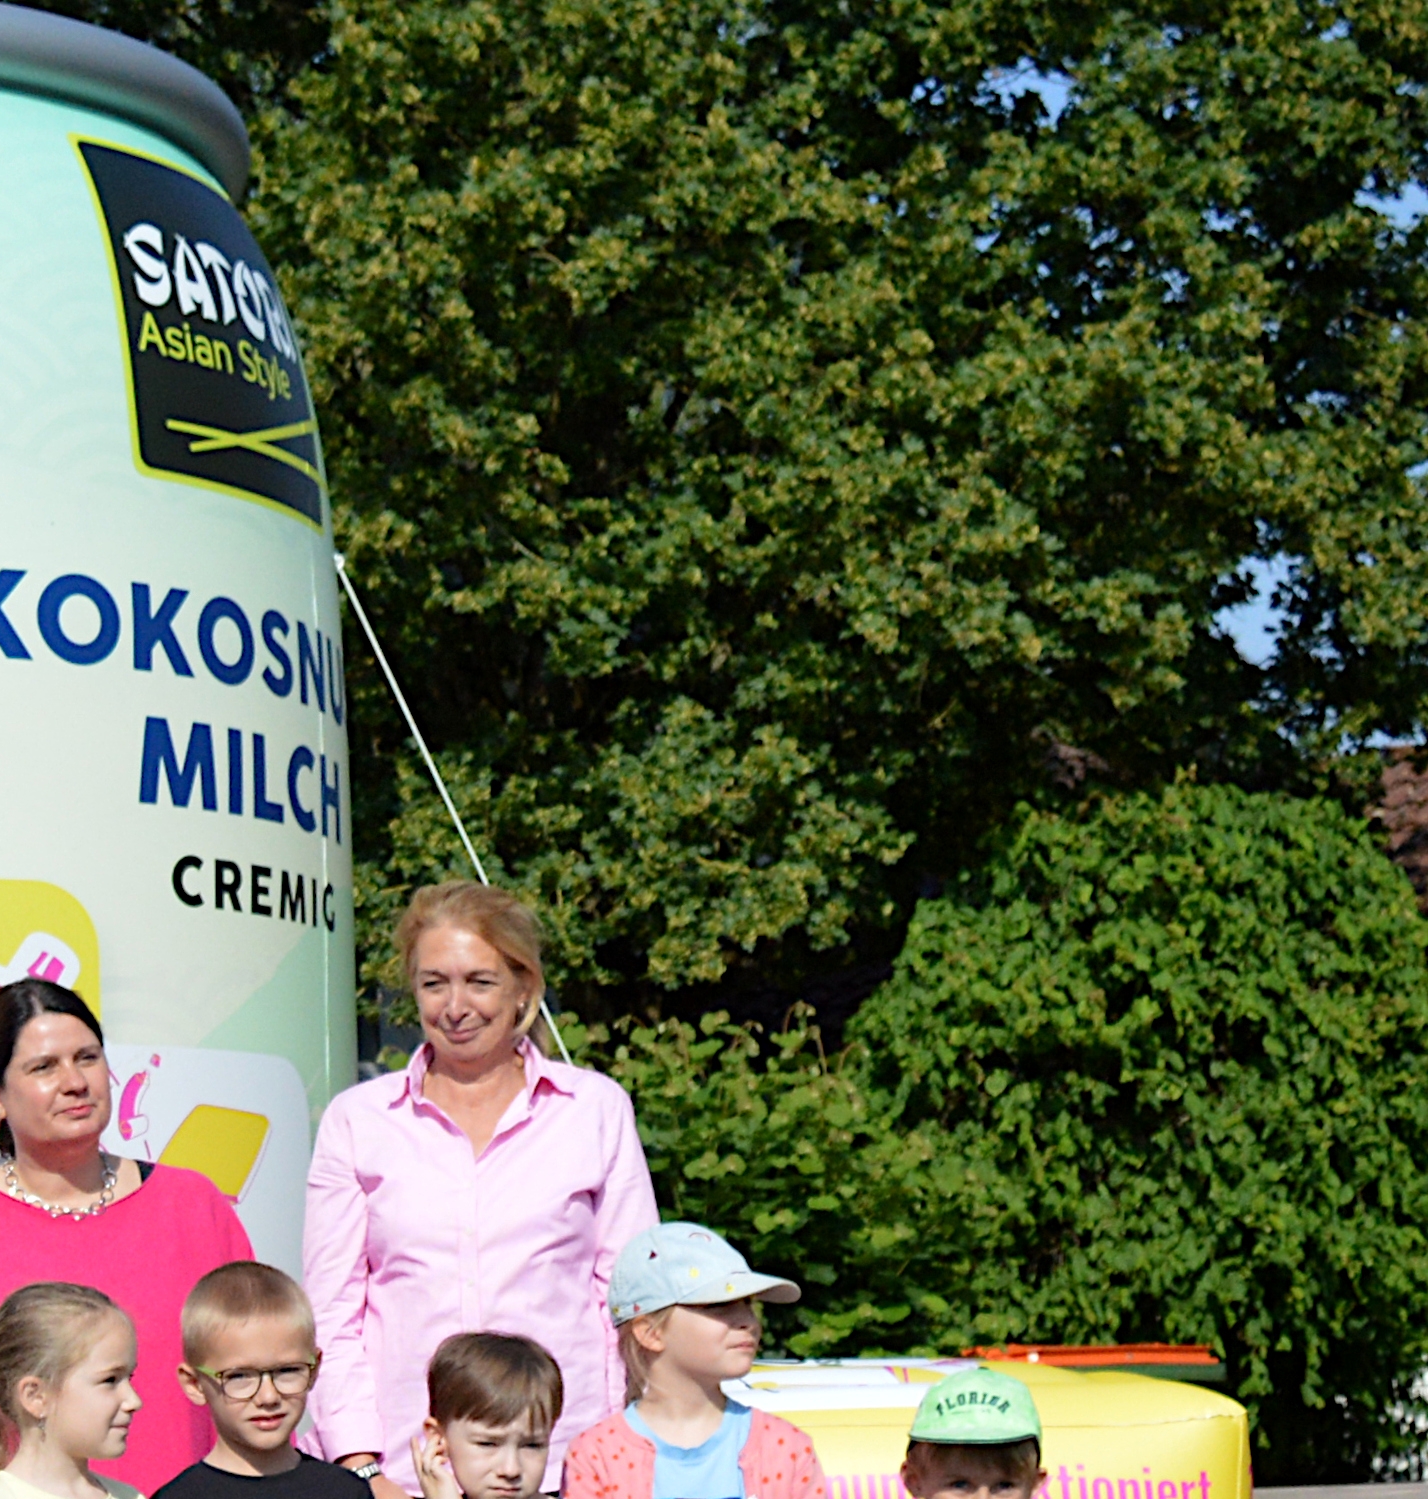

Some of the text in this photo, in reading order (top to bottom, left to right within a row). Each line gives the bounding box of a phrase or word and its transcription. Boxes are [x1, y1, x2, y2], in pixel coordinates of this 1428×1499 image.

[138, 310, 292, 400] Asian Style
[138, 714, 341, 845] MILCH
[171, 853, 335, 933] CREMIG
